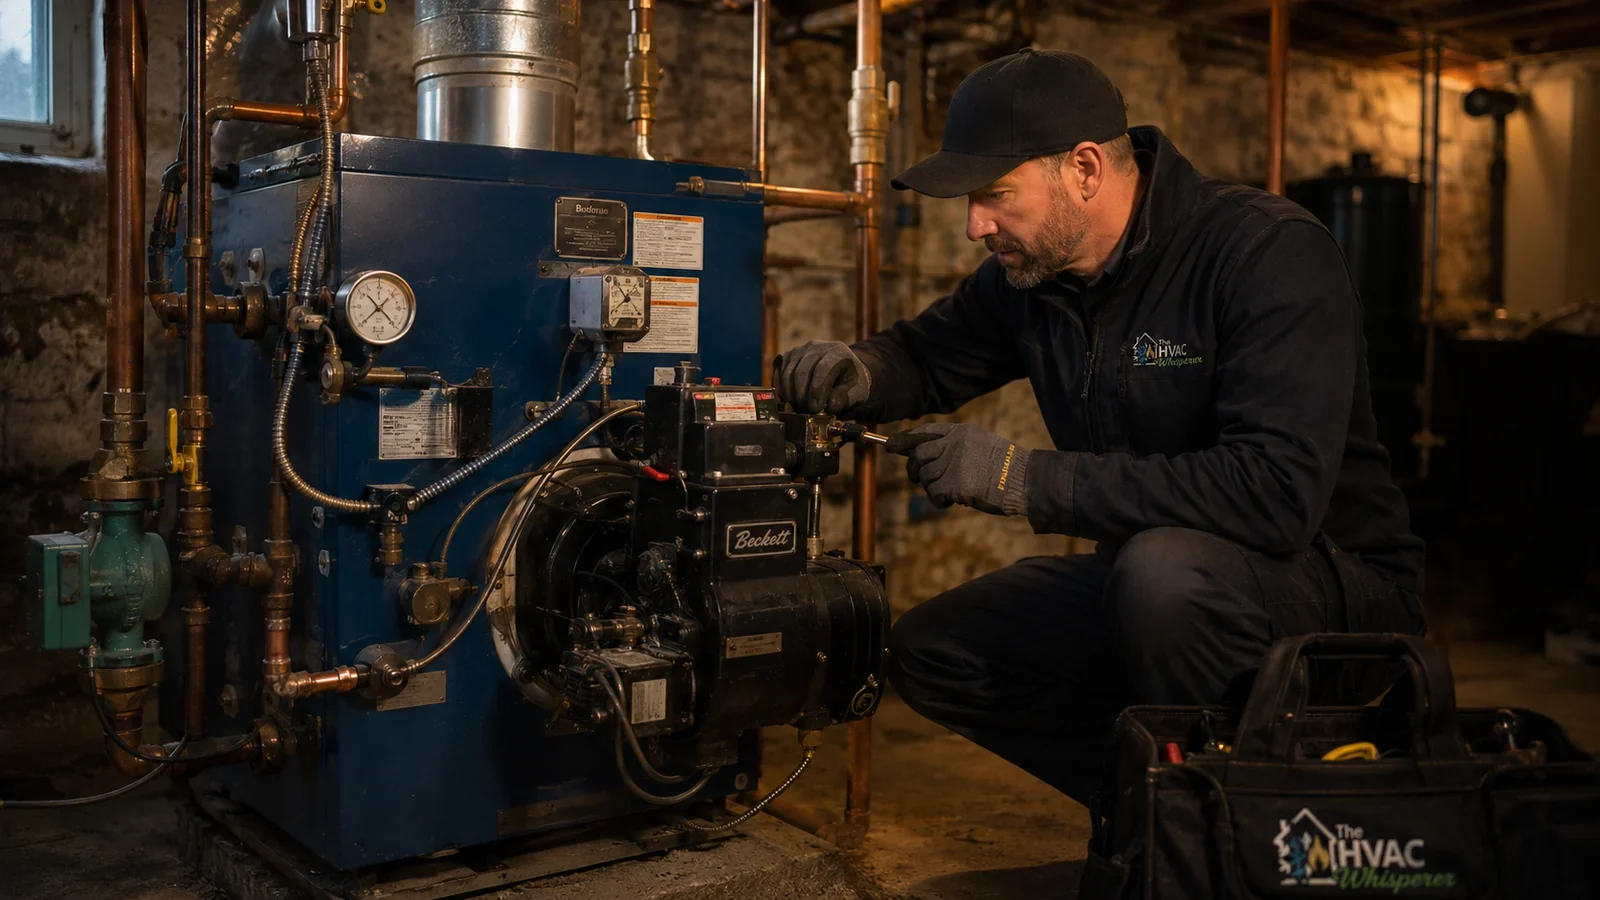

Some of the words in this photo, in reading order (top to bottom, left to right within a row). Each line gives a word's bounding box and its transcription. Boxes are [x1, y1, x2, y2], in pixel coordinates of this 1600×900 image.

[1158, 344, 1187, 358] HVAC
[734, 529, 791, 550] Beckett
[1335, 824, 1364, 839] The
[1338, 839, 1426, 868] HVAC
[1332, 866, 1457, 894] Whisperer
